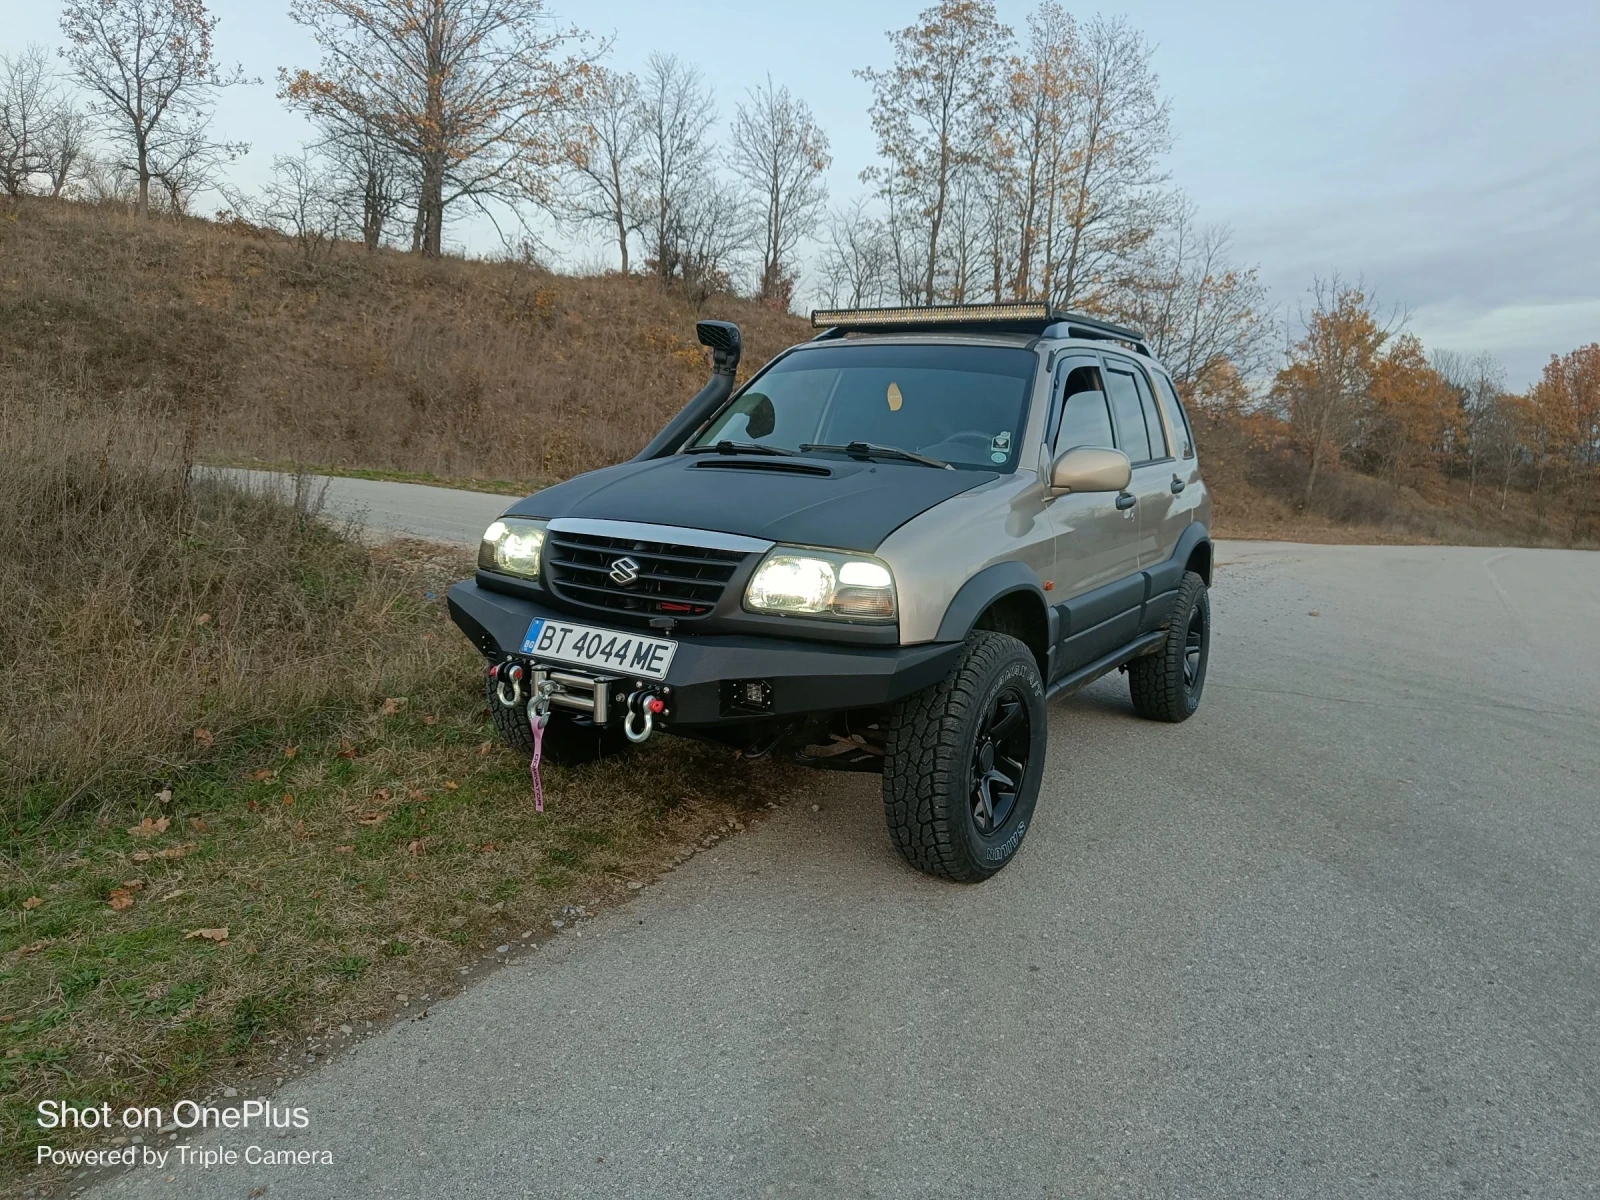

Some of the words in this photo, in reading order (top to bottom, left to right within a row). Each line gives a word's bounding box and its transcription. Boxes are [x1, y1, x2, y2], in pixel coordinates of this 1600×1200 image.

[523, 639, 535, 649] BG
[537, 625, 574, 654] BT
[571, 631, 633, 668] 4044
[629, 641, 670, 674] ME
[532, 753, 542, 807] DOMINATOR
[986, 820, 1026, 861] SAILUN
